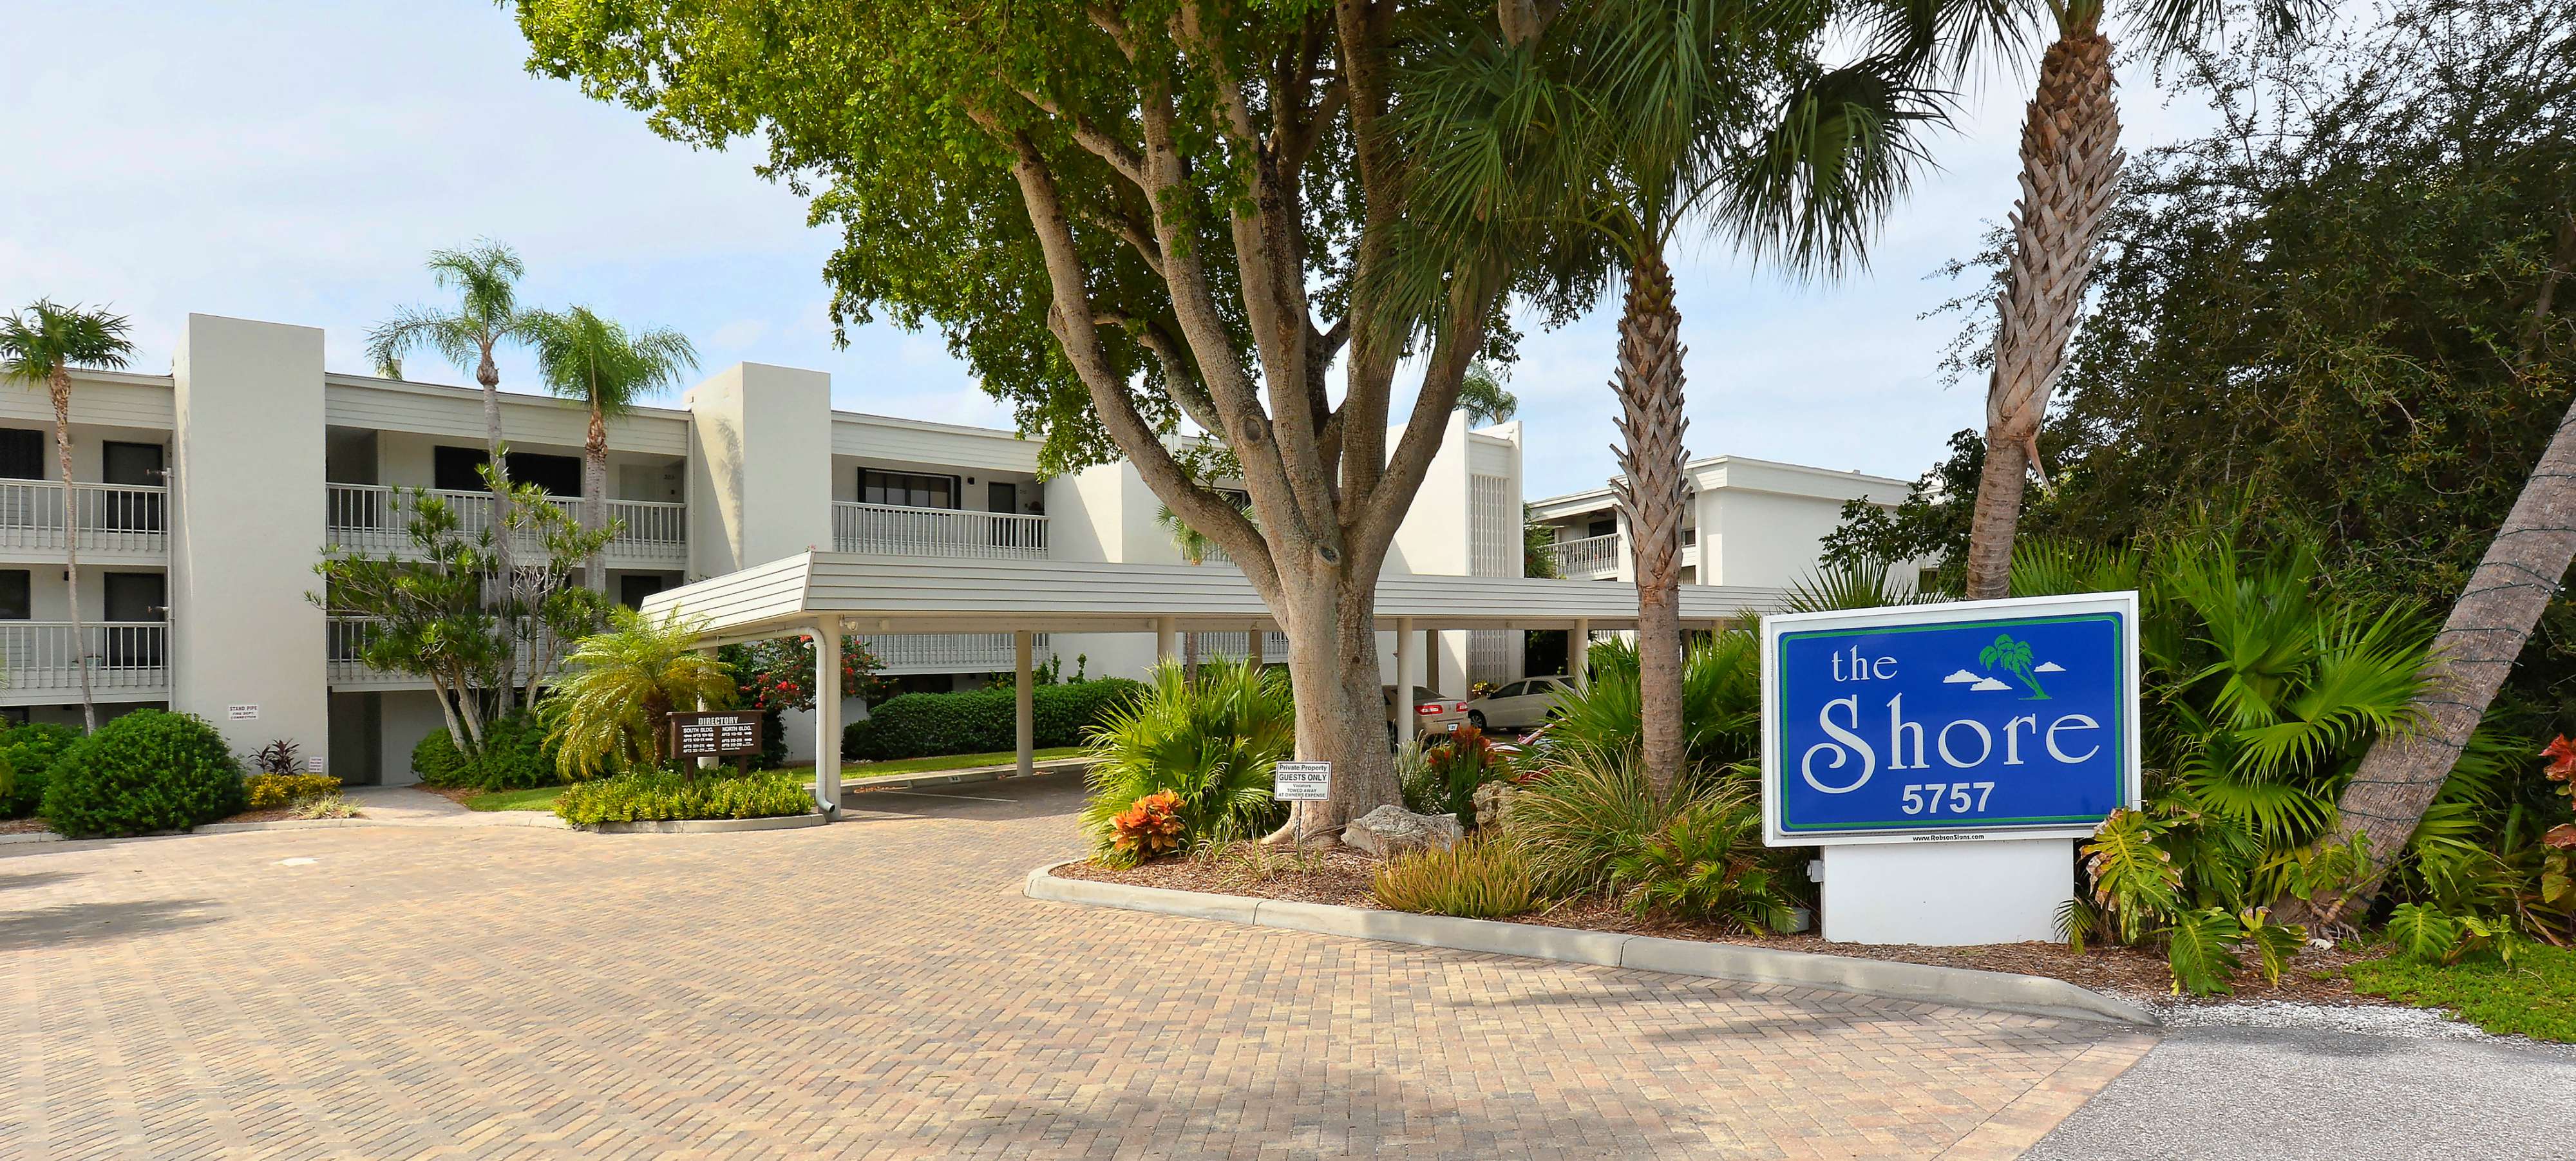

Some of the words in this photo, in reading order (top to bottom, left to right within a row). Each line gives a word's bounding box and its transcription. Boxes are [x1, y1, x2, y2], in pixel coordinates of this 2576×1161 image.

[1831, 644, 1898, 682] the
[698, 717, 739, 725] DIRECTORY
[1801, 692, 2100, 794] Shore
[1901, 781, 1995, 815] 5757
